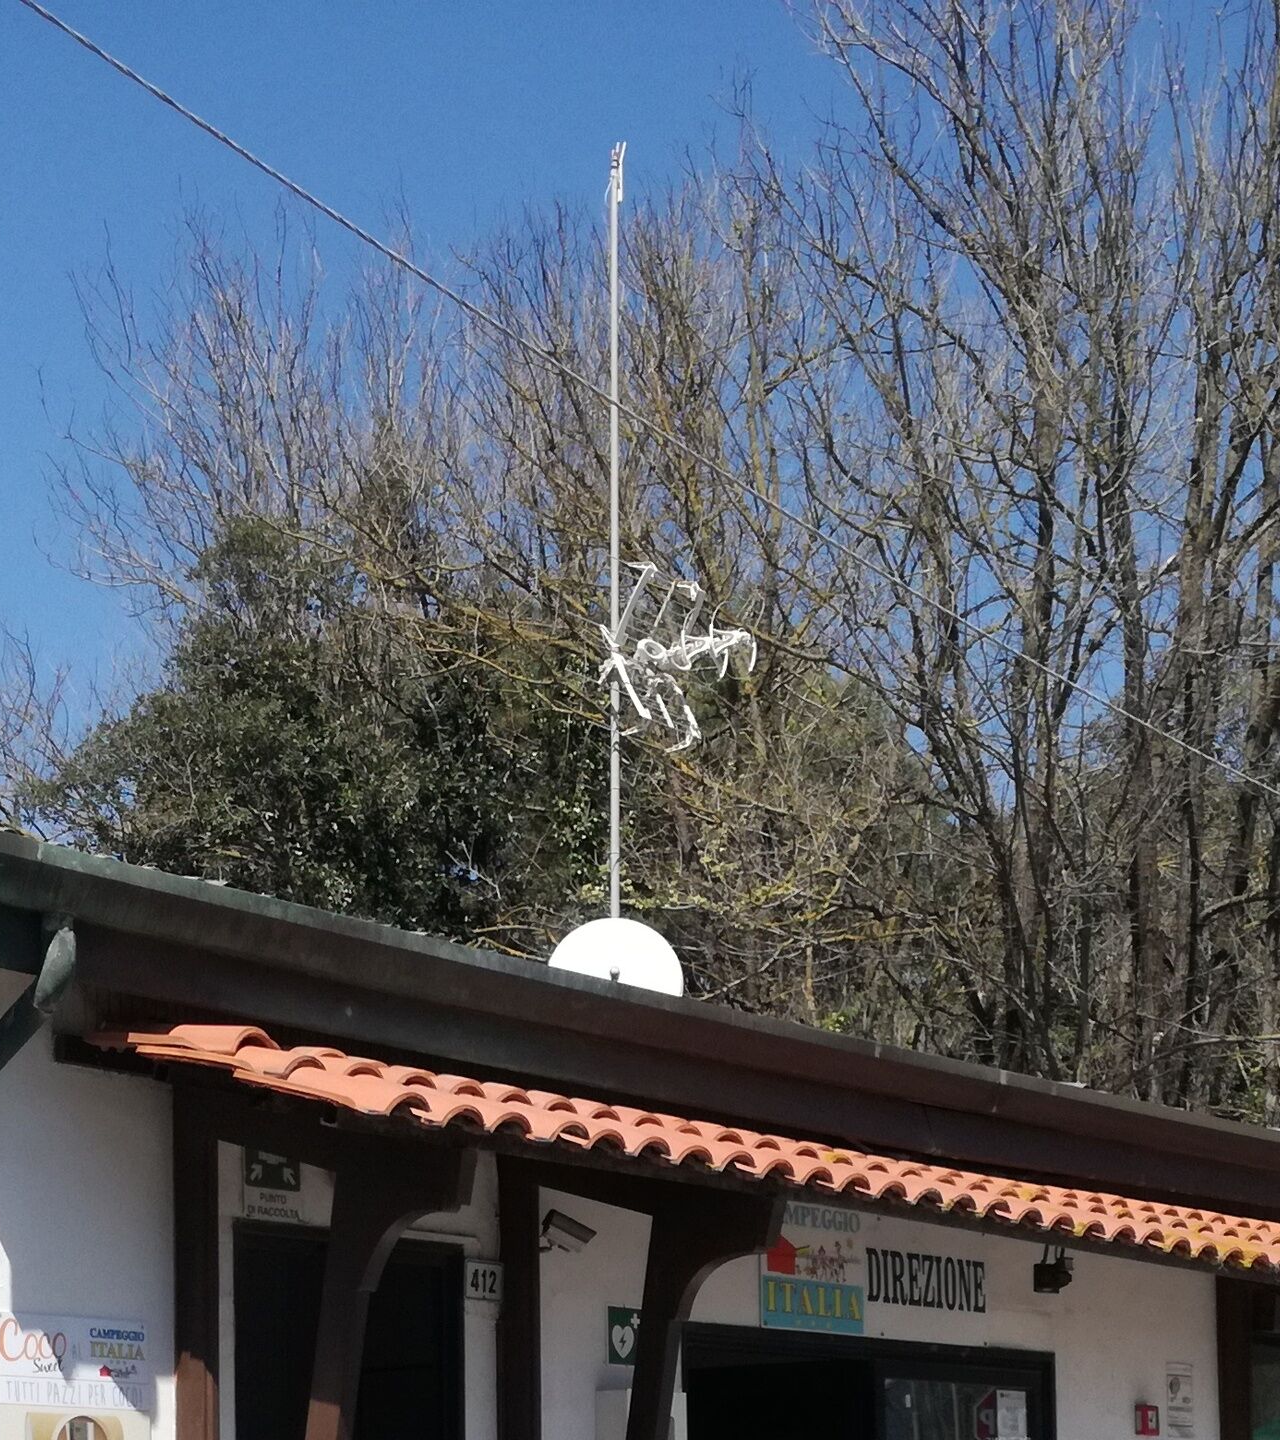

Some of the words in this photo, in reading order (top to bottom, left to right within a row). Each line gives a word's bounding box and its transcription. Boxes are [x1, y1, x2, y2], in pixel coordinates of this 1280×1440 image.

[260, 1192, 287, 1205] PUNTO
[247, 1205, 256, 1215] DI
[258, 1206, 300, 1219] RACCOLTA
[784, 1204, 861, 1233] MPEGGIO
[471, 1269, 496, 1294] 412
[866, 1247, 986, 1314] DIREZIONE
[767, 1281, 862, 1321] ITALIA
[90, 1327, 145, 1342] CAMPEGGIO
[90, 1341, 146, 1361] ITALIA
[7, 1381, 40, 1402] TUTTI
[47, 1382, 81, 1404] PAZZI
[89, 1384, 106, 1406] PER
